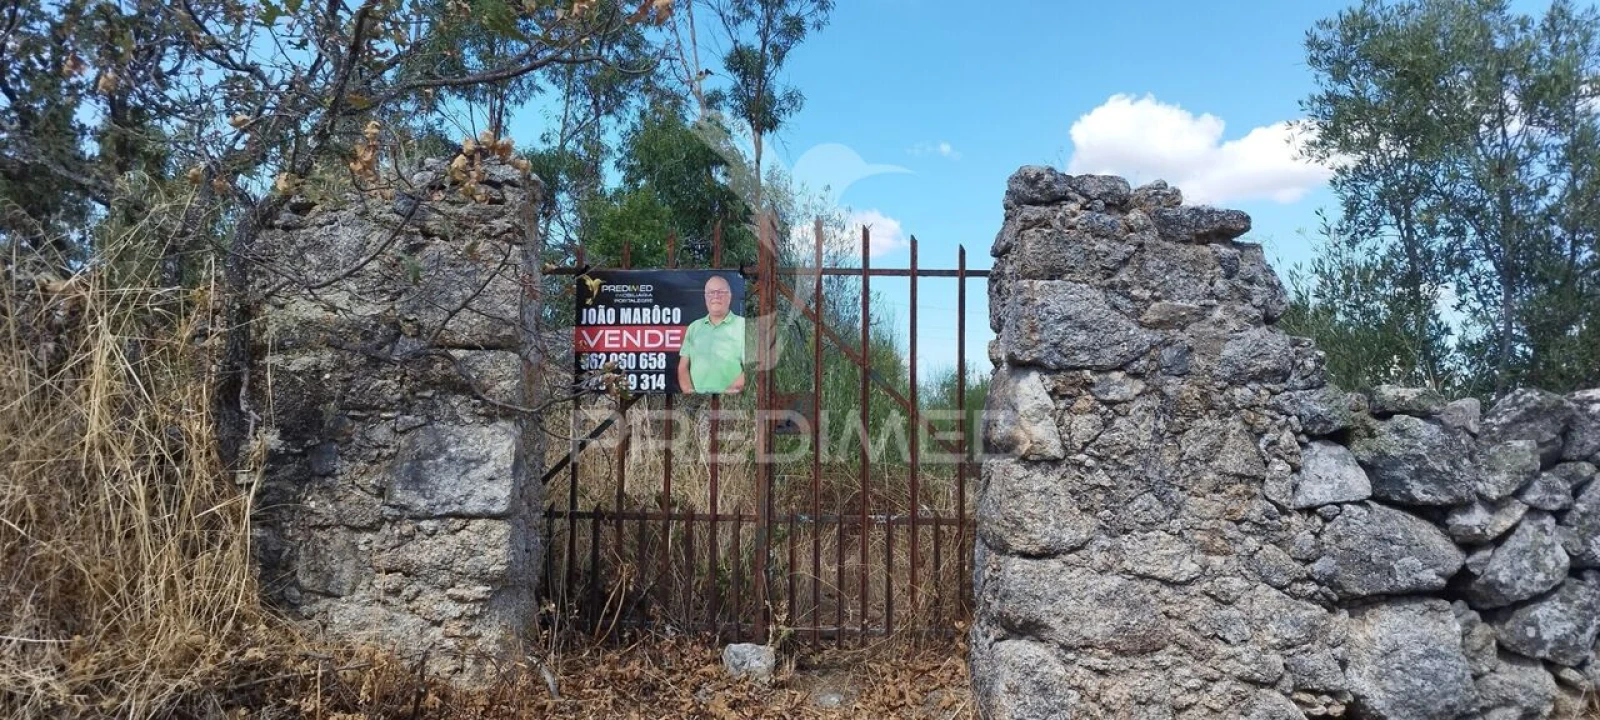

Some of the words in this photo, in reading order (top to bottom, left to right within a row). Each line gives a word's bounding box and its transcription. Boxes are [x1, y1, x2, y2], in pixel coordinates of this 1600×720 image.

[601, 284, 653, 292] PREDIMED
[581, 305, 616, 325] JOÃO
[620, 305, 681, 325] MARÔCO
[581, 329, 682, 348] VENDE
[639, 352, 666, 370] 658
[640, 373, 666, 391] 314
